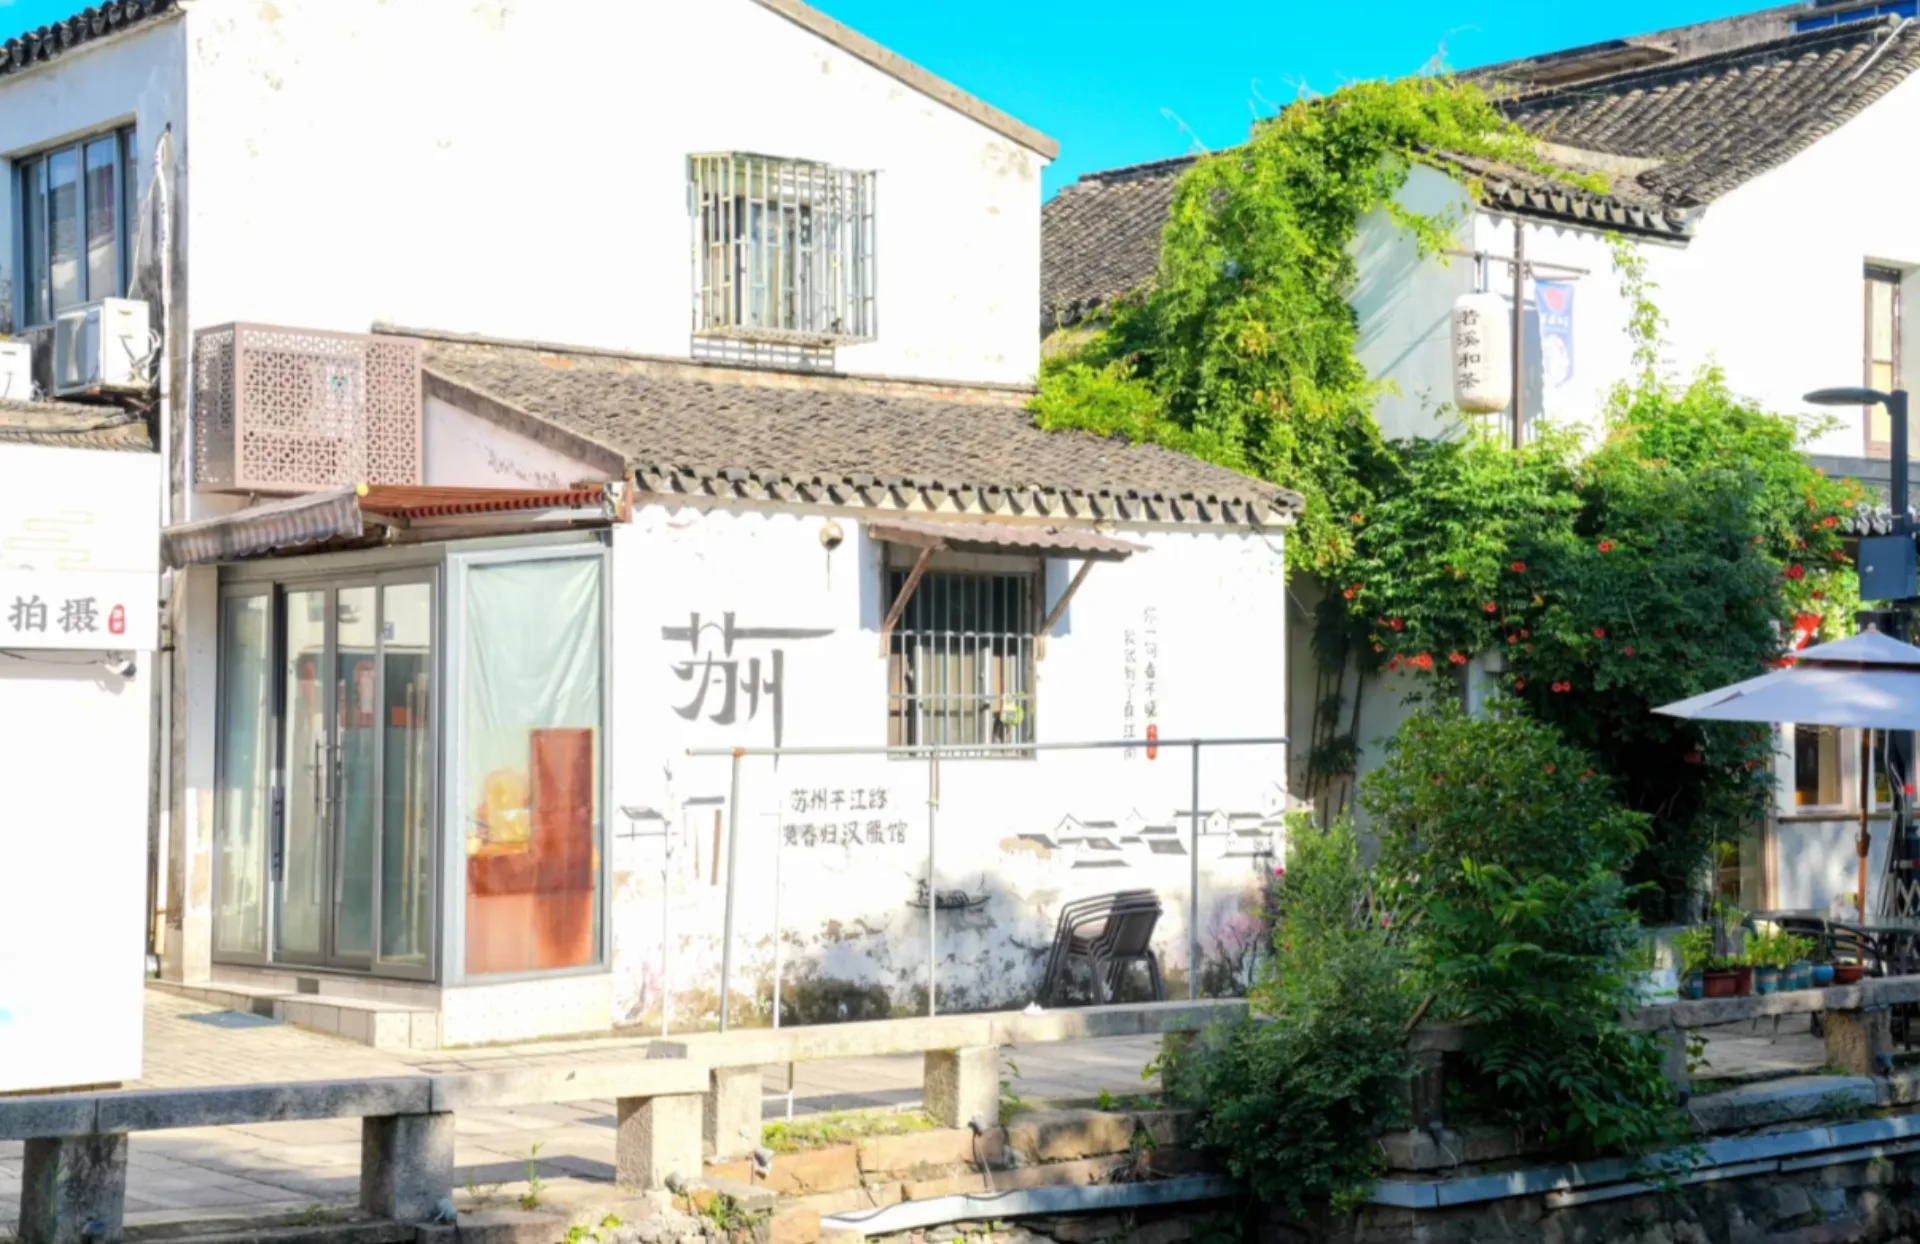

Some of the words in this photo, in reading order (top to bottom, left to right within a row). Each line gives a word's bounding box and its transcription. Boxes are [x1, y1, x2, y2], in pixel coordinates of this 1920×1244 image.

[7, 594, 100, 634] 拍摄
[661, 611, 836, 769] 苏州
[791, 787, 889, 814] 苏州平江路
